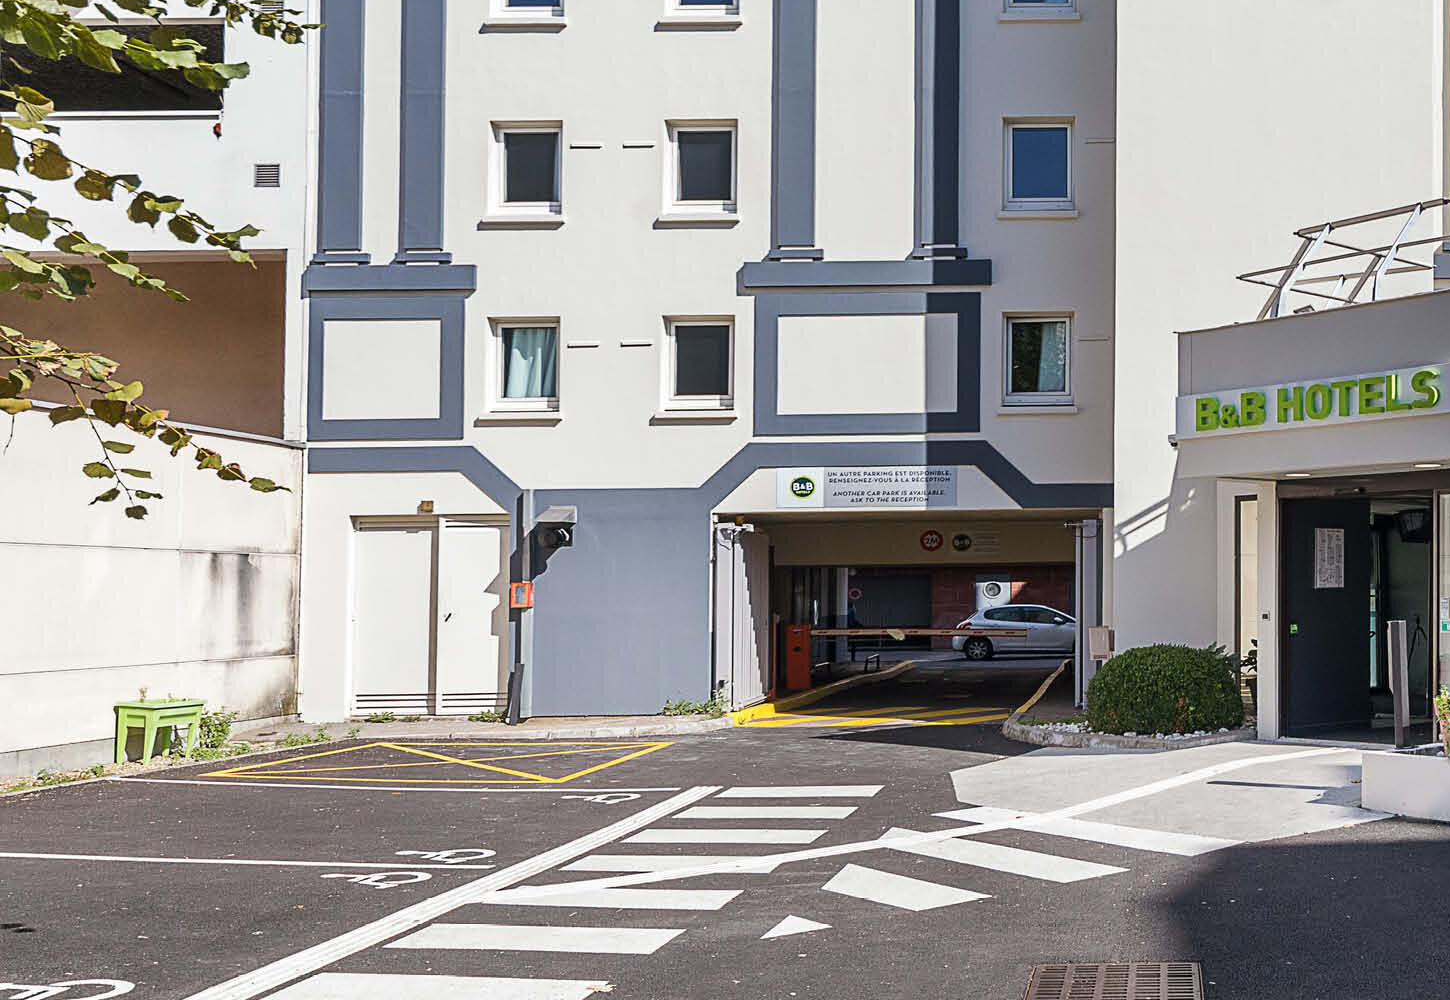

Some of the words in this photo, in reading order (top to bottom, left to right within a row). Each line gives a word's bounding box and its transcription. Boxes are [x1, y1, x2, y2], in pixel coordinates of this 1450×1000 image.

[1195, 391, 1267, 432] B&B
[1276, 370, 1441, 424] HOTELS
[792, 482, 813, 491] B&B
